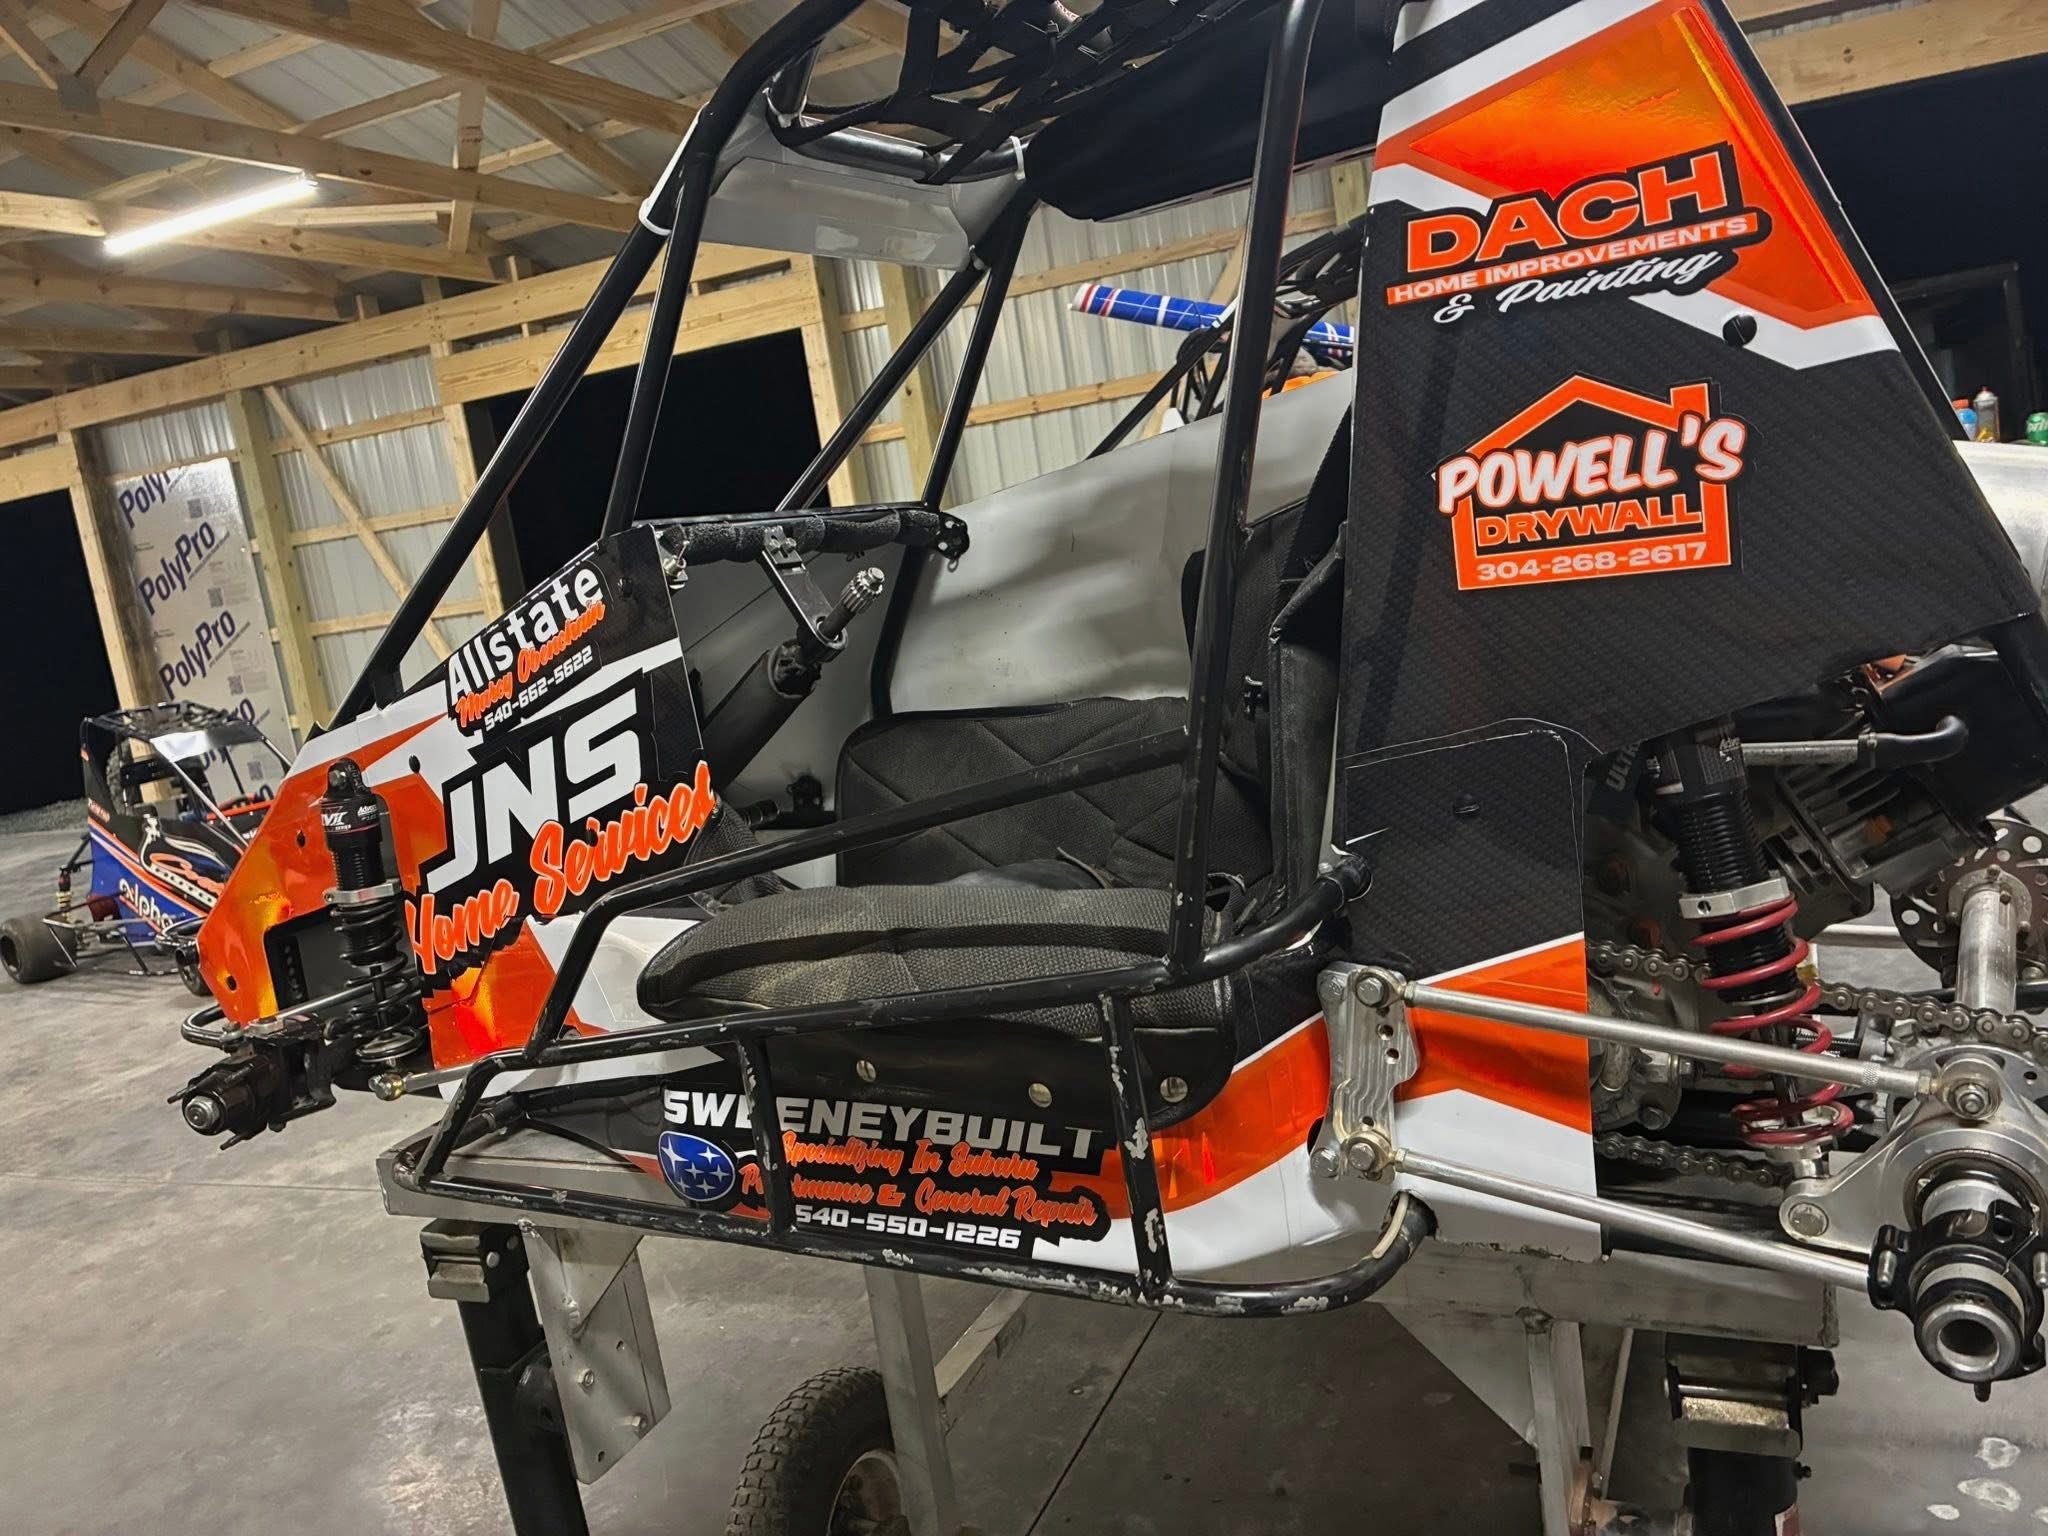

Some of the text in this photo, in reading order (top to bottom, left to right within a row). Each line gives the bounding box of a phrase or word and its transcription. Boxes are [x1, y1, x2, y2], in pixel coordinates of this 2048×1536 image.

[1407, 151, 1728, 274] DACH
[1395, 216, 1749, 303] HOME IMPROVEMENTS
[1433, 250, 1723, 324] & Painting
[1438, 411, 1747, 515] POWELL'S
[1475, 493, 1703, 548] DRYWALL
[1476, 541, 1708, 582] 304-268-2617
[139, 521, 216, 616] PolyPro
[158, 610, 236, 700] PolyPro
[449, 568, 604, 706] Allstate
[484, 645, 594, 731] 540-662-5622
[427, 687, 642, 894] JNS
[405, 760, 717, 974] Home Services
[909, 1138, 943, 1175] In
[950, 1141, 1040, 1181] Subaru
[915, 1177, 1012, 1217] General
[1011, 1184, 1099, 1228] Repair
[795, 1204, 1022, 1250] 540-550-1226
